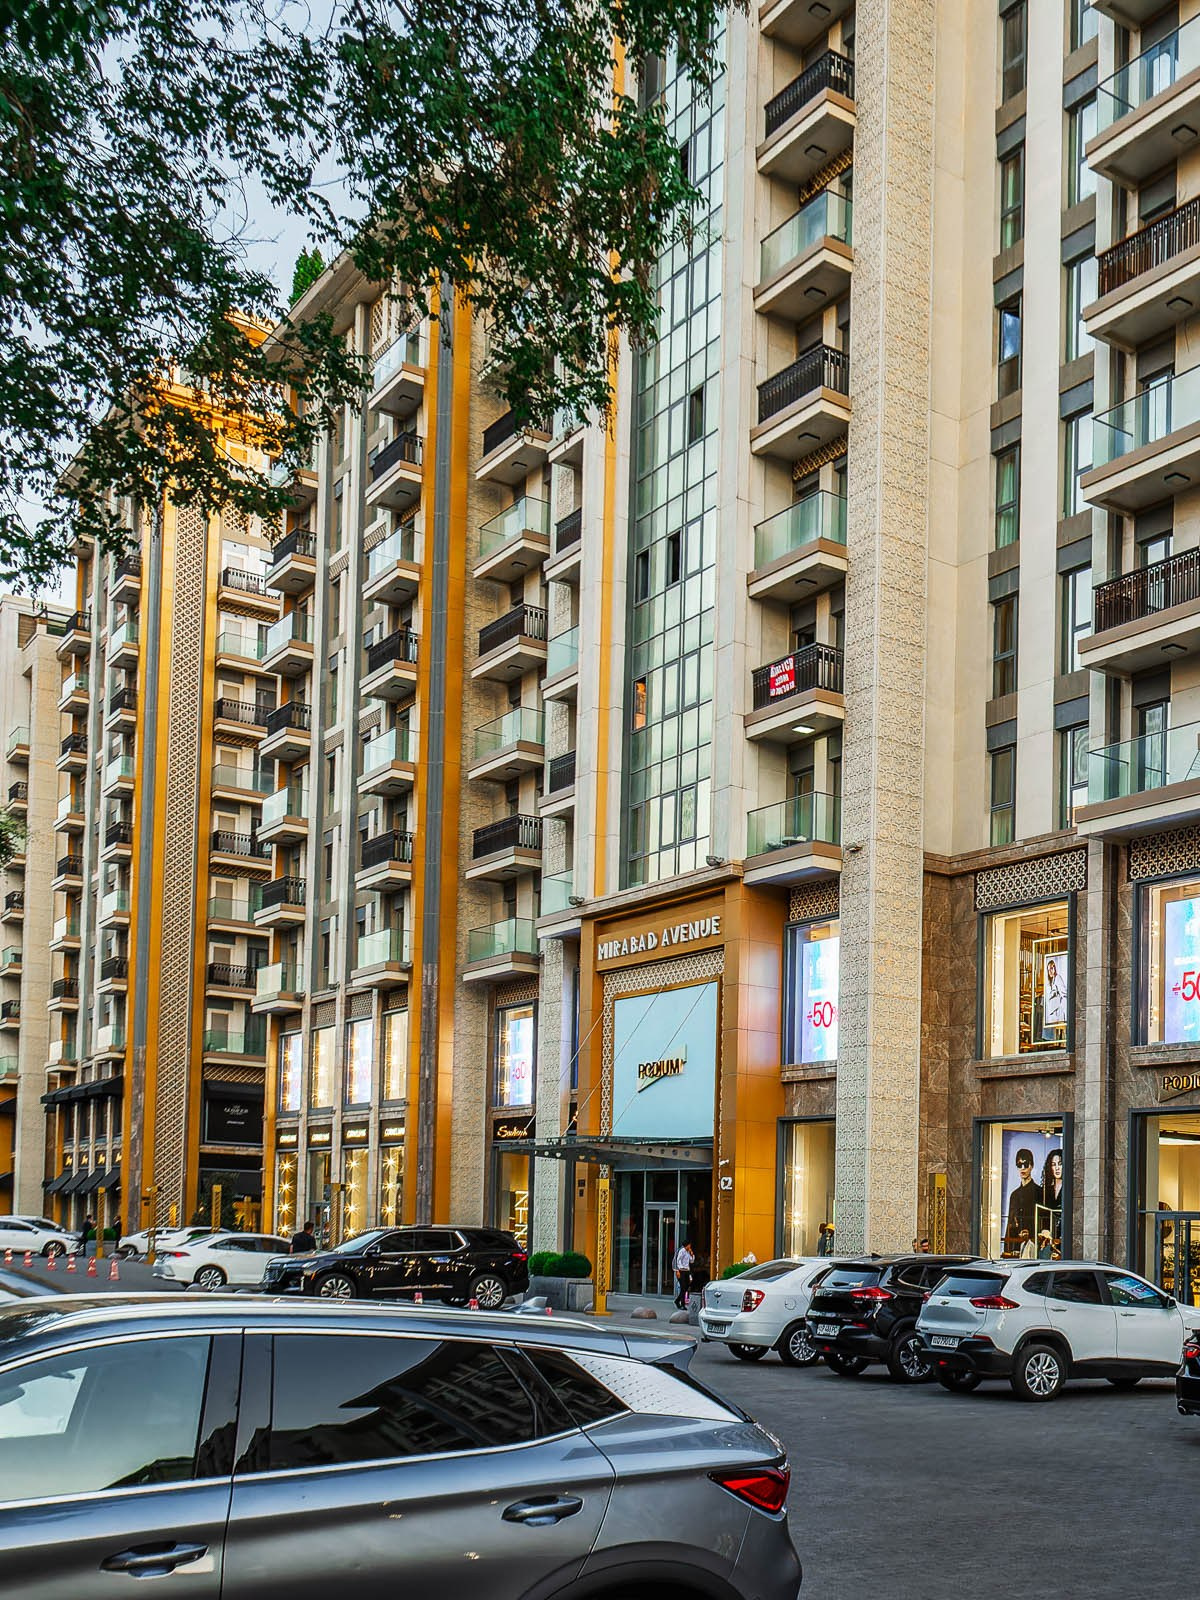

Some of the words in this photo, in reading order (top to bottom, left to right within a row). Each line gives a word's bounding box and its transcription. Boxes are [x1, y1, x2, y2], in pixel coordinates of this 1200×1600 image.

[597, 932, 658, 961] MIRABAD
[661, 915, 721, 947] AVENUE
[638, 1058, 684, 1079] PODIUM
